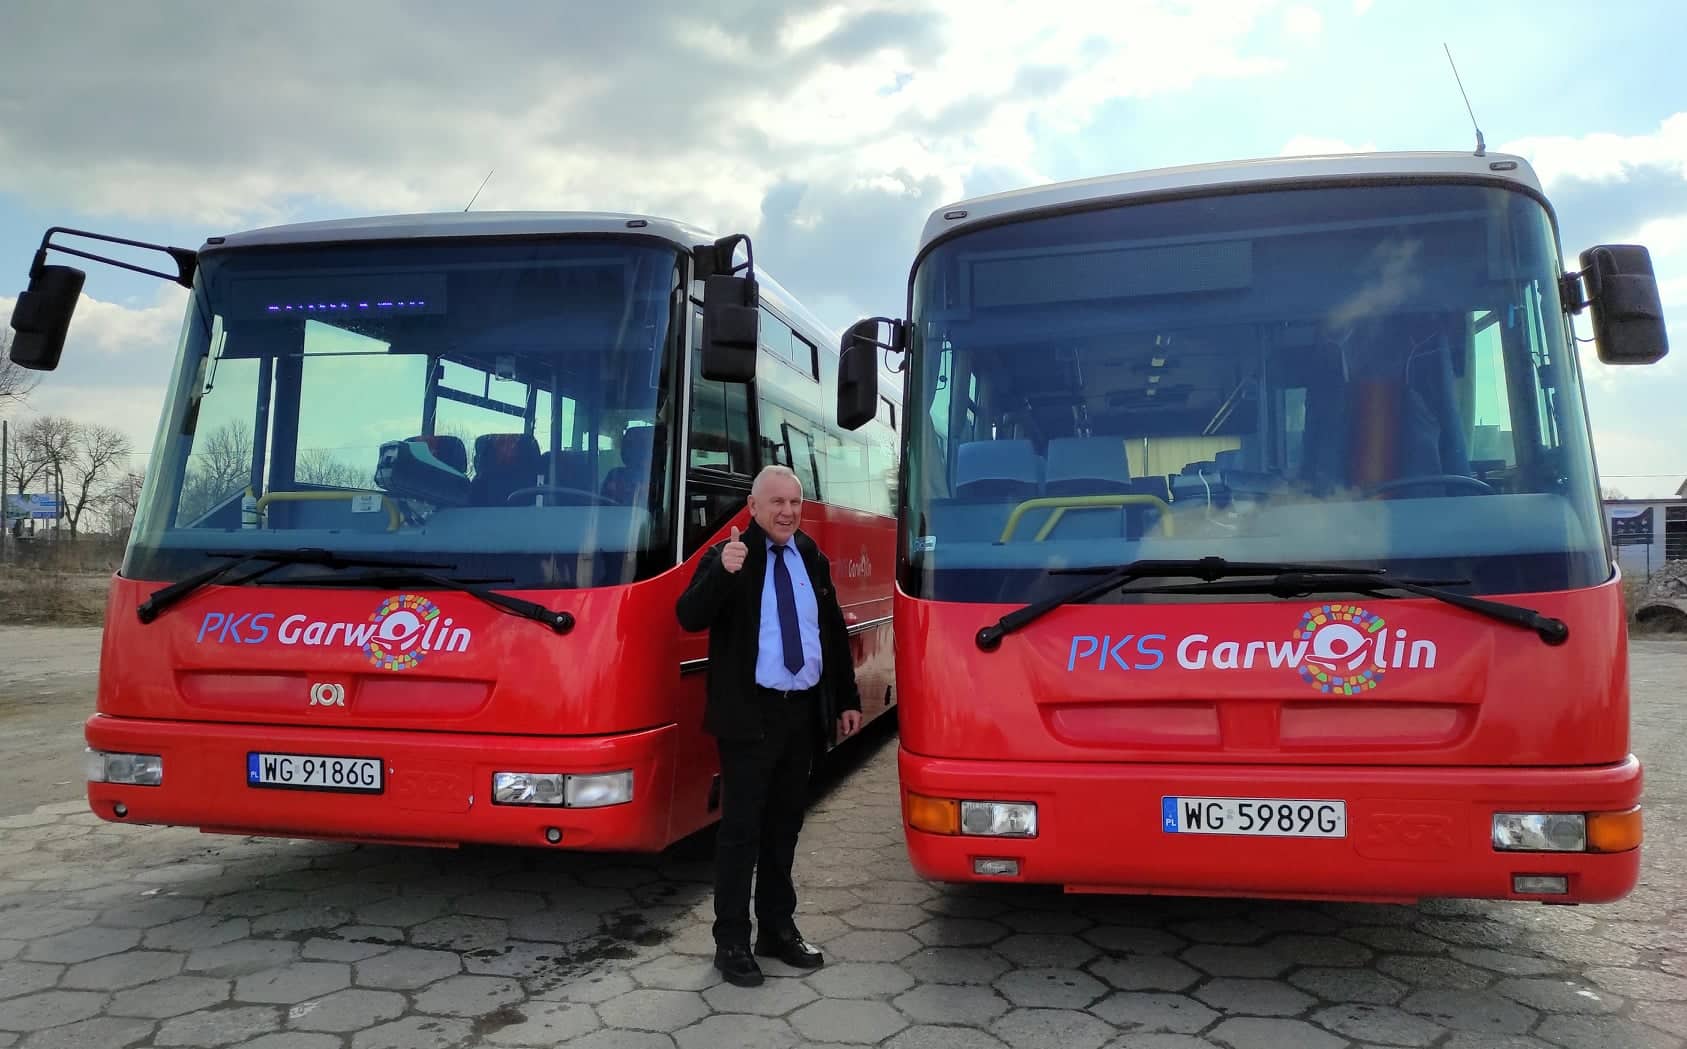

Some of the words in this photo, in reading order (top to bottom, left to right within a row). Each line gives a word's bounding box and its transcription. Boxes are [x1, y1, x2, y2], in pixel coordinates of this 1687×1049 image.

[197, 612, 275, 644] PKS
[278, 609, 471, 653] Garwolin
[1067, 633, 1166, 672] PKS
[1176, 623, 1437, 672] Garwolin
[264, 757, 293, 782] WG
[302, 759, 375, 786] 9186G
[1165, 818, 1177, 828] PL
[1185, 802, 1224, 830] WG
[1238, 803, 1337, 833] 5989G
